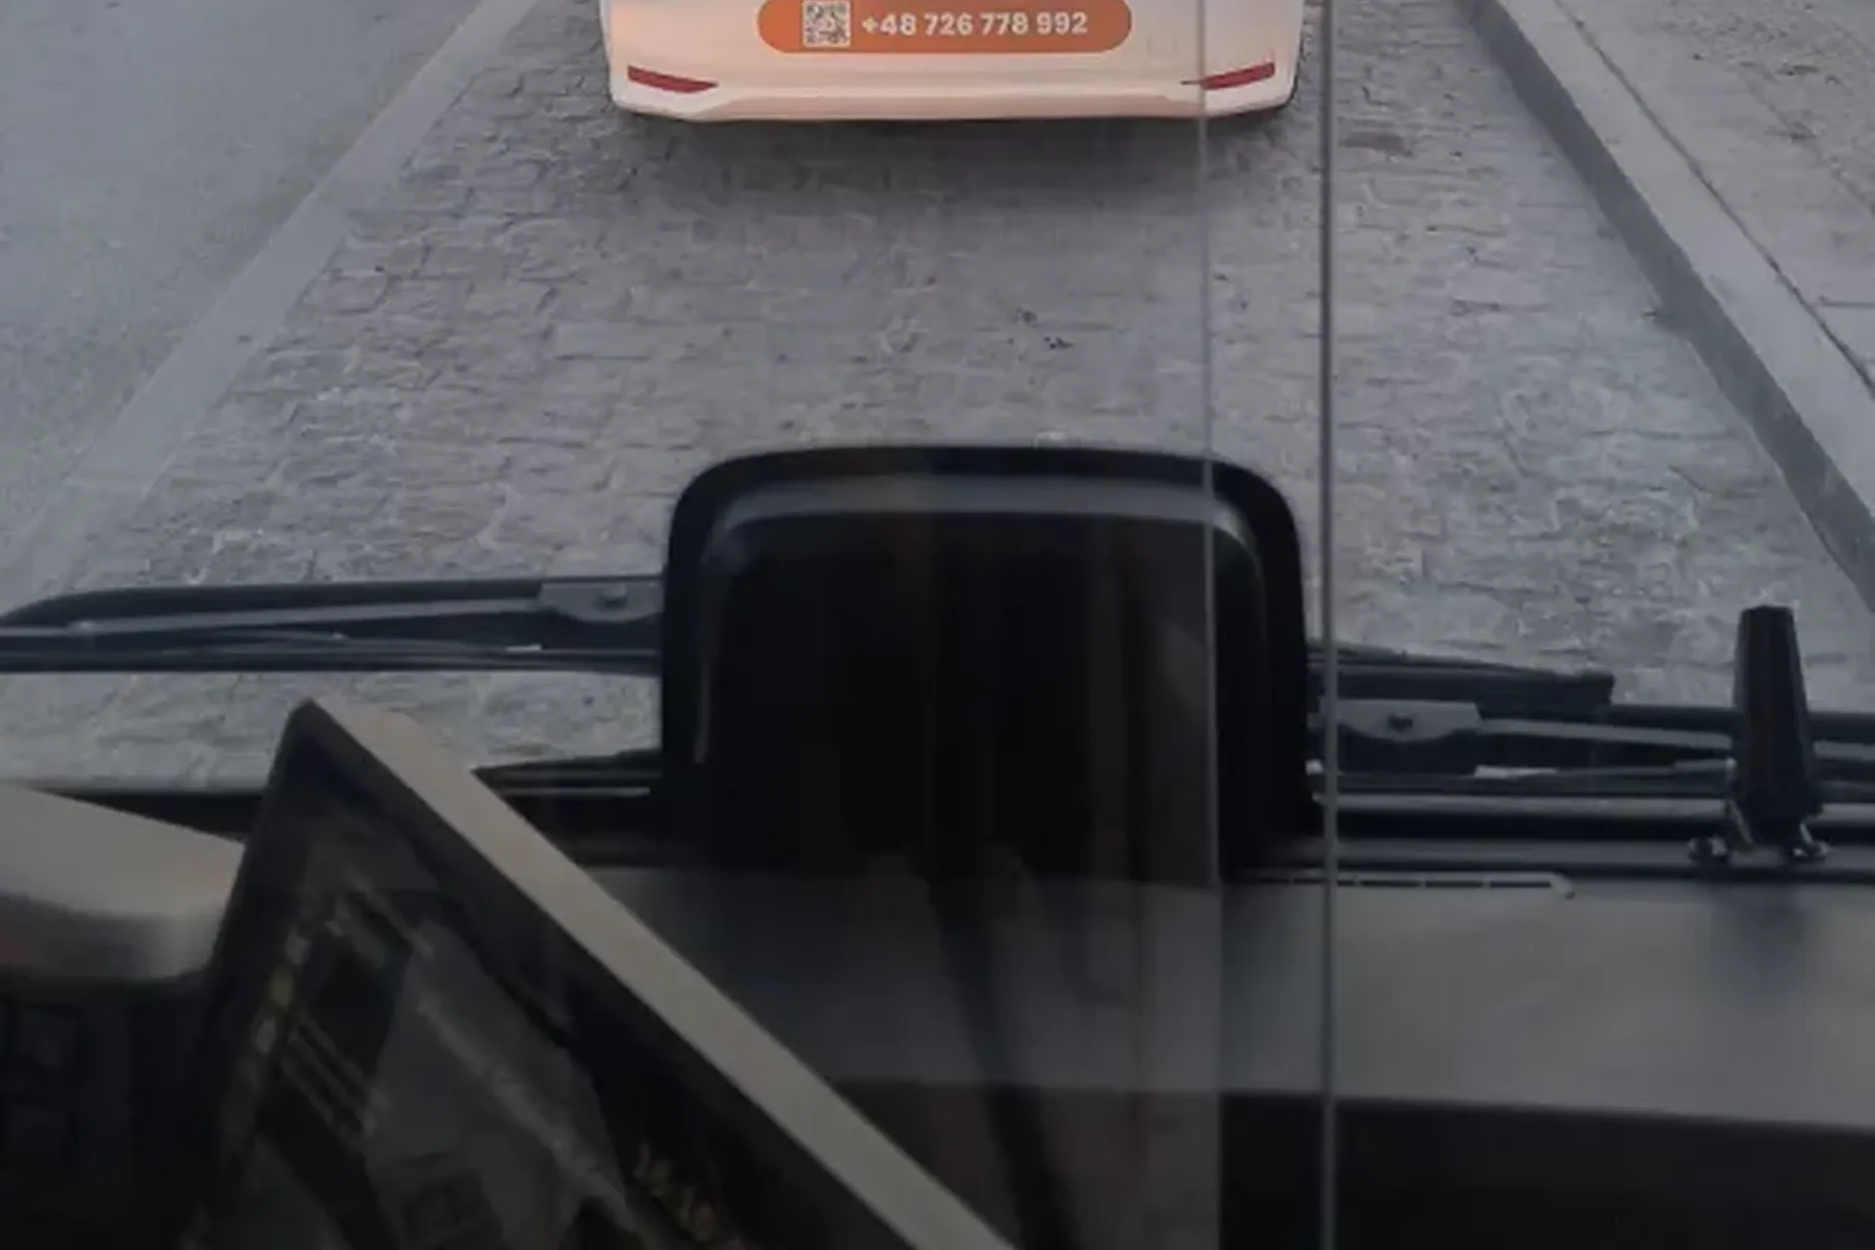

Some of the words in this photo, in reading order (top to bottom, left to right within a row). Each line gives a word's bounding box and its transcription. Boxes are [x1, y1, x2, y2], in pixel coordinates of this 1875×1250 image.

[862, 13, 917, 35] +48
[924, 13, 974, 35] 726
[980, 13, 1029, 35] 778
[1036, 11, 1088, 34] 992
